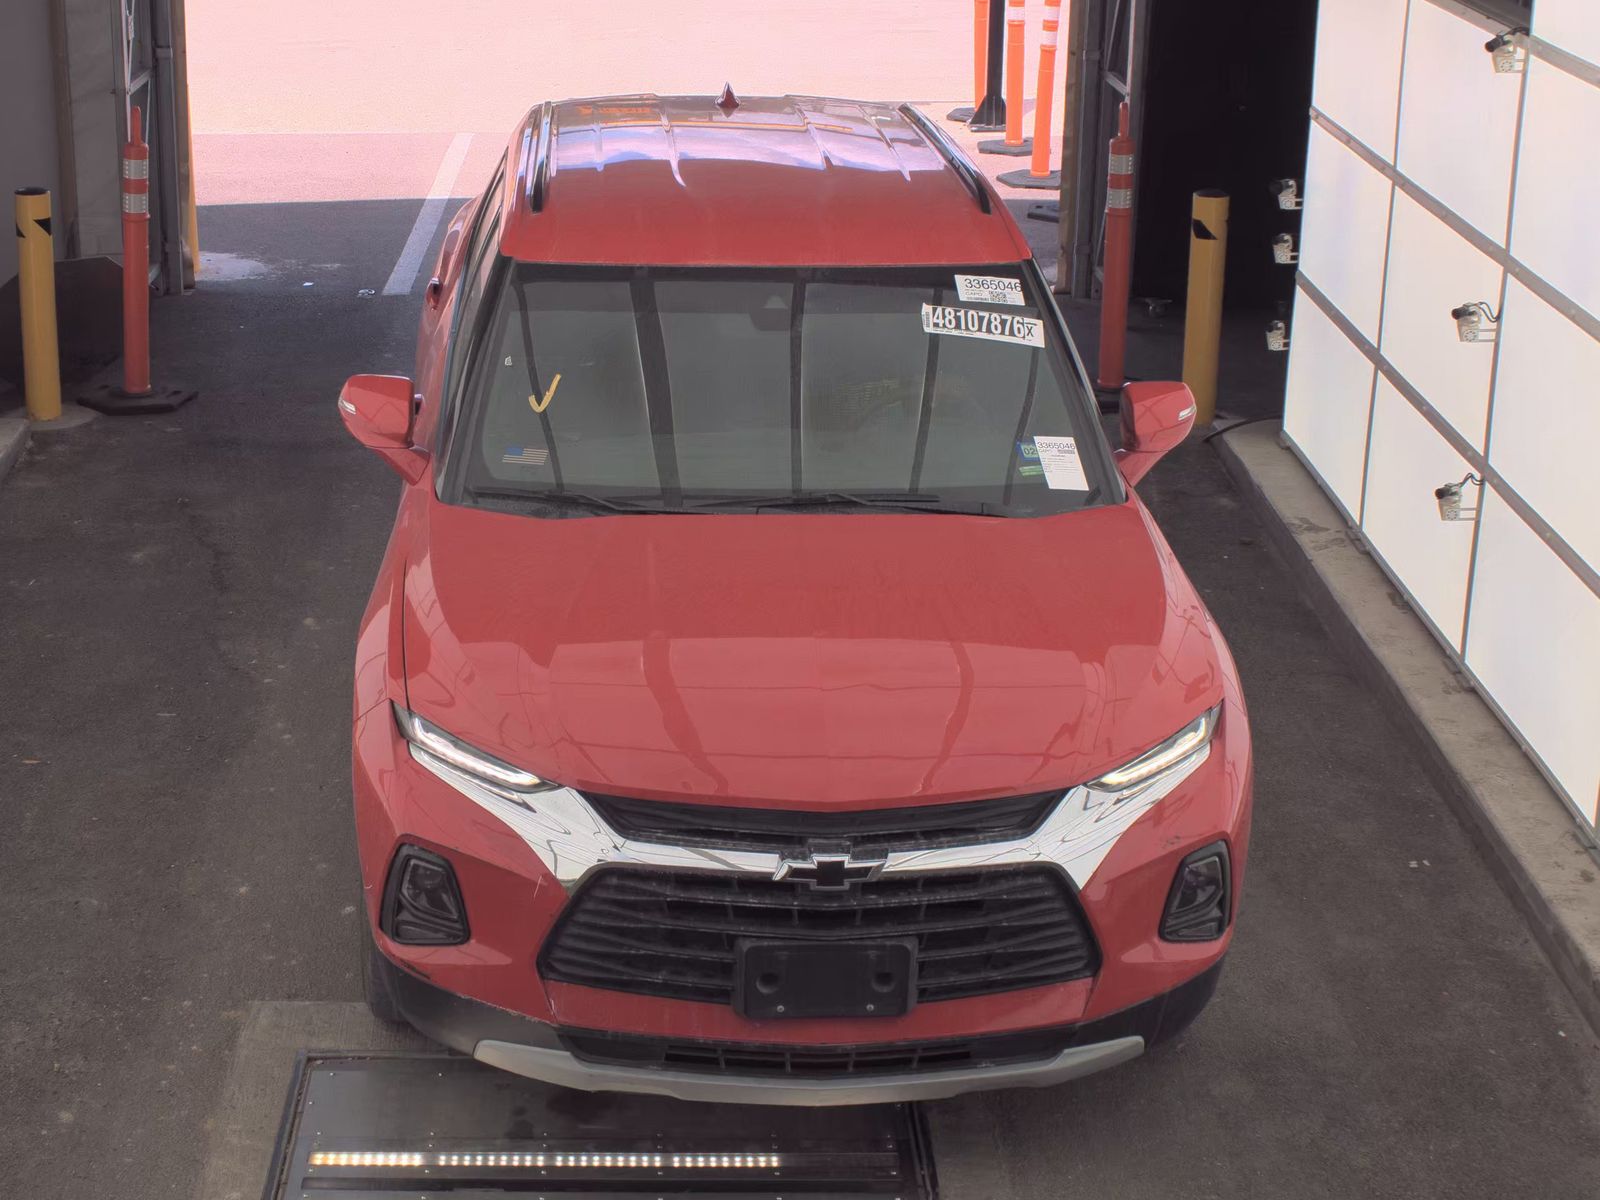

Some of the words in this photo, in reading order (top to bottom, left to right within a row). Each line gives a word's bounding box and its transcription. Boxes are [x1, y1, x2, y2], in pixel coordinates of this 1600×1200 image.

[964, 278, 1022, 293] 3365046
[933, 306, 1024, 338] 48107876
[1037, 441, 1076, 450] 3365046
